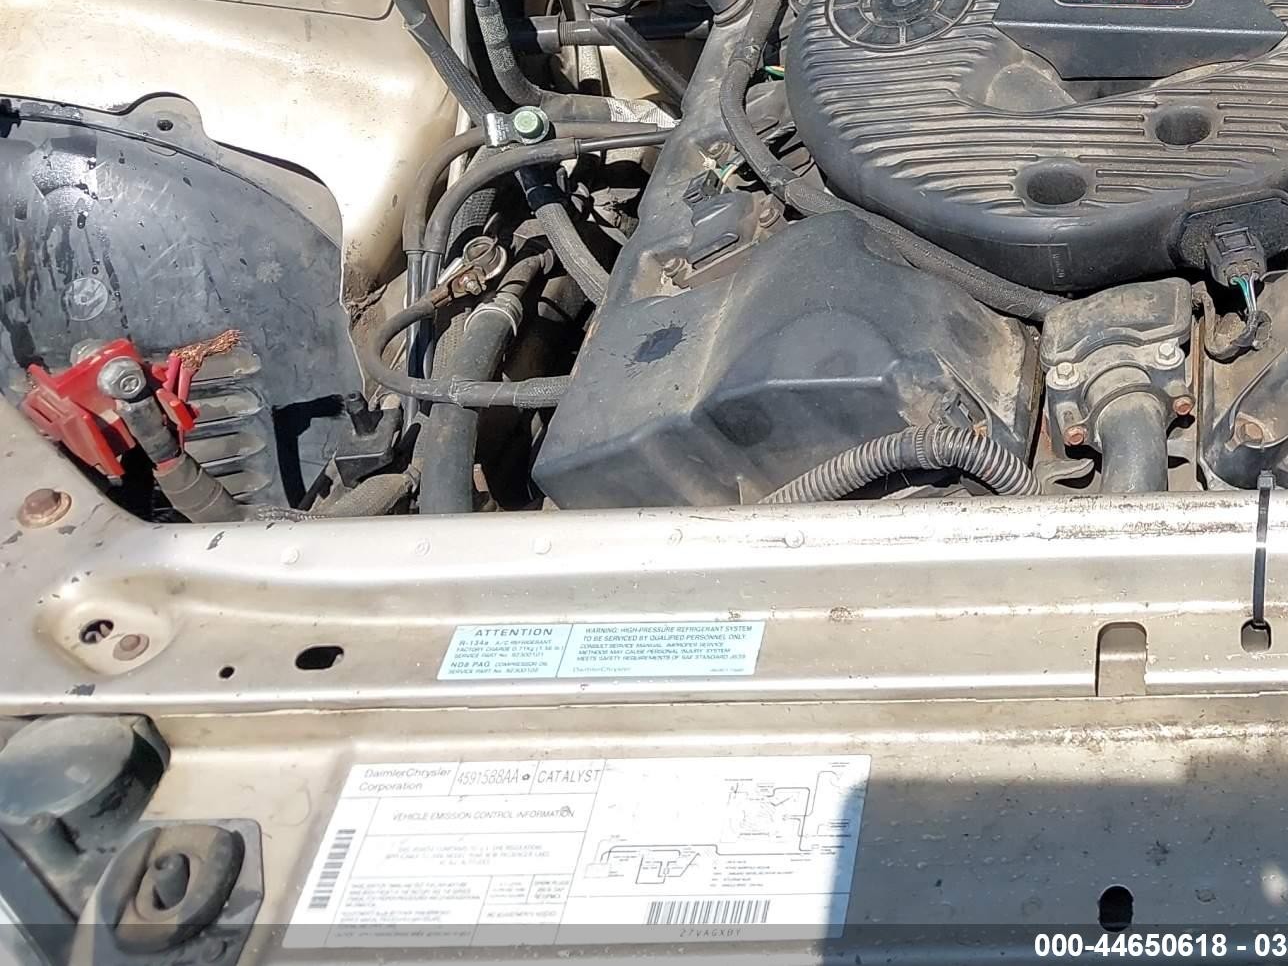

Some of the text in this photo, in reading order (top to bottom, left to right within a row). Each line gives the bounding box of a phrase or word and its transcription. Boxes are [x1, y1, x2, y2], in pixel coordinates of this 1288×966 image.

[474, 628, 553, 636] ATTENTION
[364, 768, 452, 779] DaimlerChrysler
[537, 769, 601, 784] CATALYST
[359, 782, 423, 793] Corporation
[393, 809, 575, 821] VEHICLE EMISSION CONTROL INFORMATION
